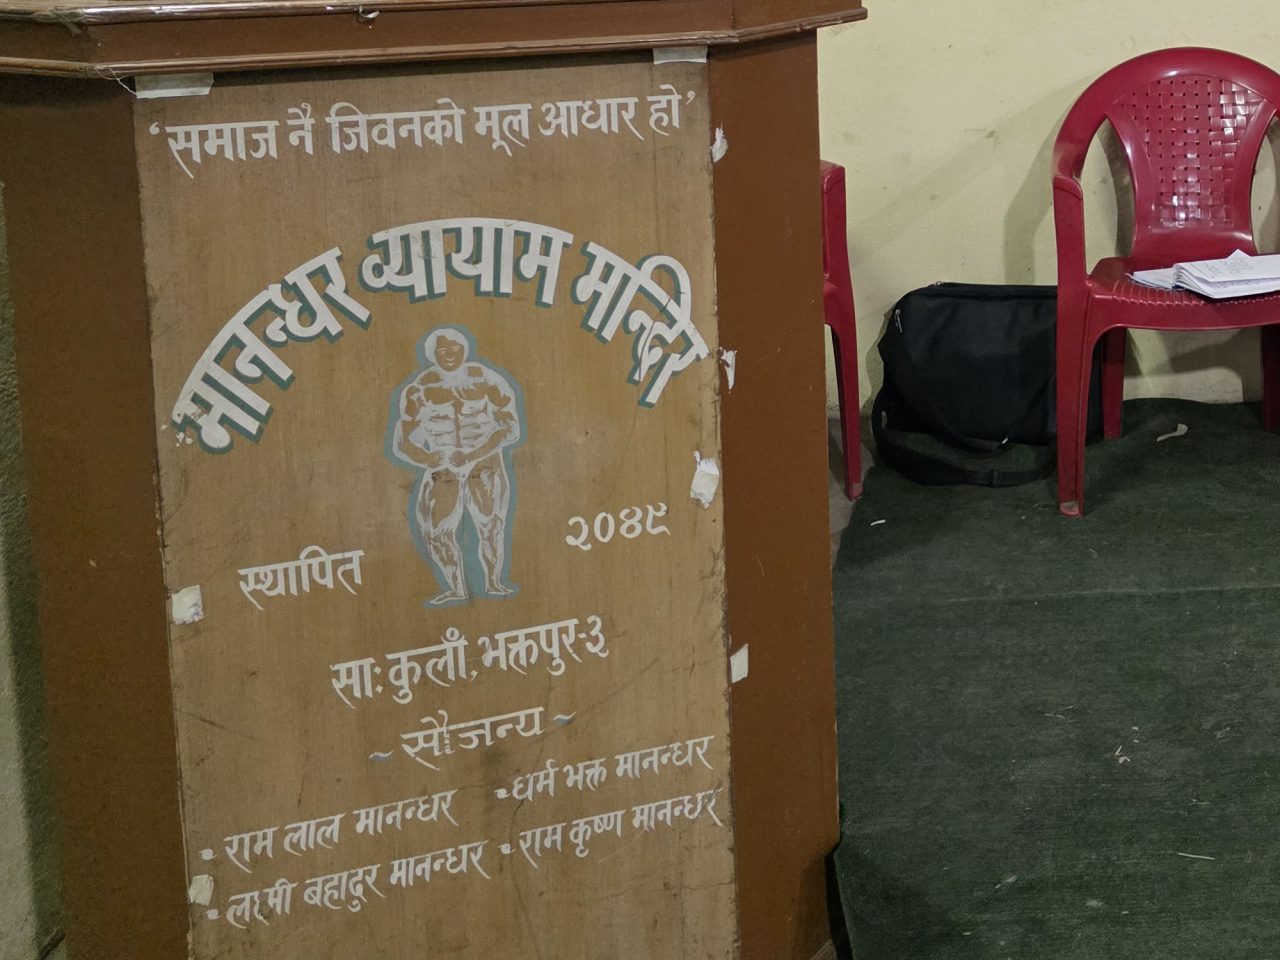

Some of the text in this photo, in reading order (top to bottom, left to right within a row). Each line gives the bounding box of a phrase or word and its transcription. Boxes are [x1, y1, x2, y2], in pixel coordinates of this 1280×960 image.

[325, 98, 466, 154] जिवनको
[473, 103, 532, 156] मूल
[538, 96, 645, 140] आधार
[171, 246, 372, 451] मानन्धर
[360, 217, 574, 307] व्यायाम
[238, 545, 365, 611] स्थापित
[401, 707, 545, 770] सौजन्य
[512, 735, 715, 801] धर्म भक्त मानन्धर
[224, 789, 459, 873] राम लाल मानन्धर
[519, 787, 723, 869] राम कृष्ण मानन्धर
[303, 863, 386, 913] बहादुर
[390, 840, 491, 889] मानन्धर
